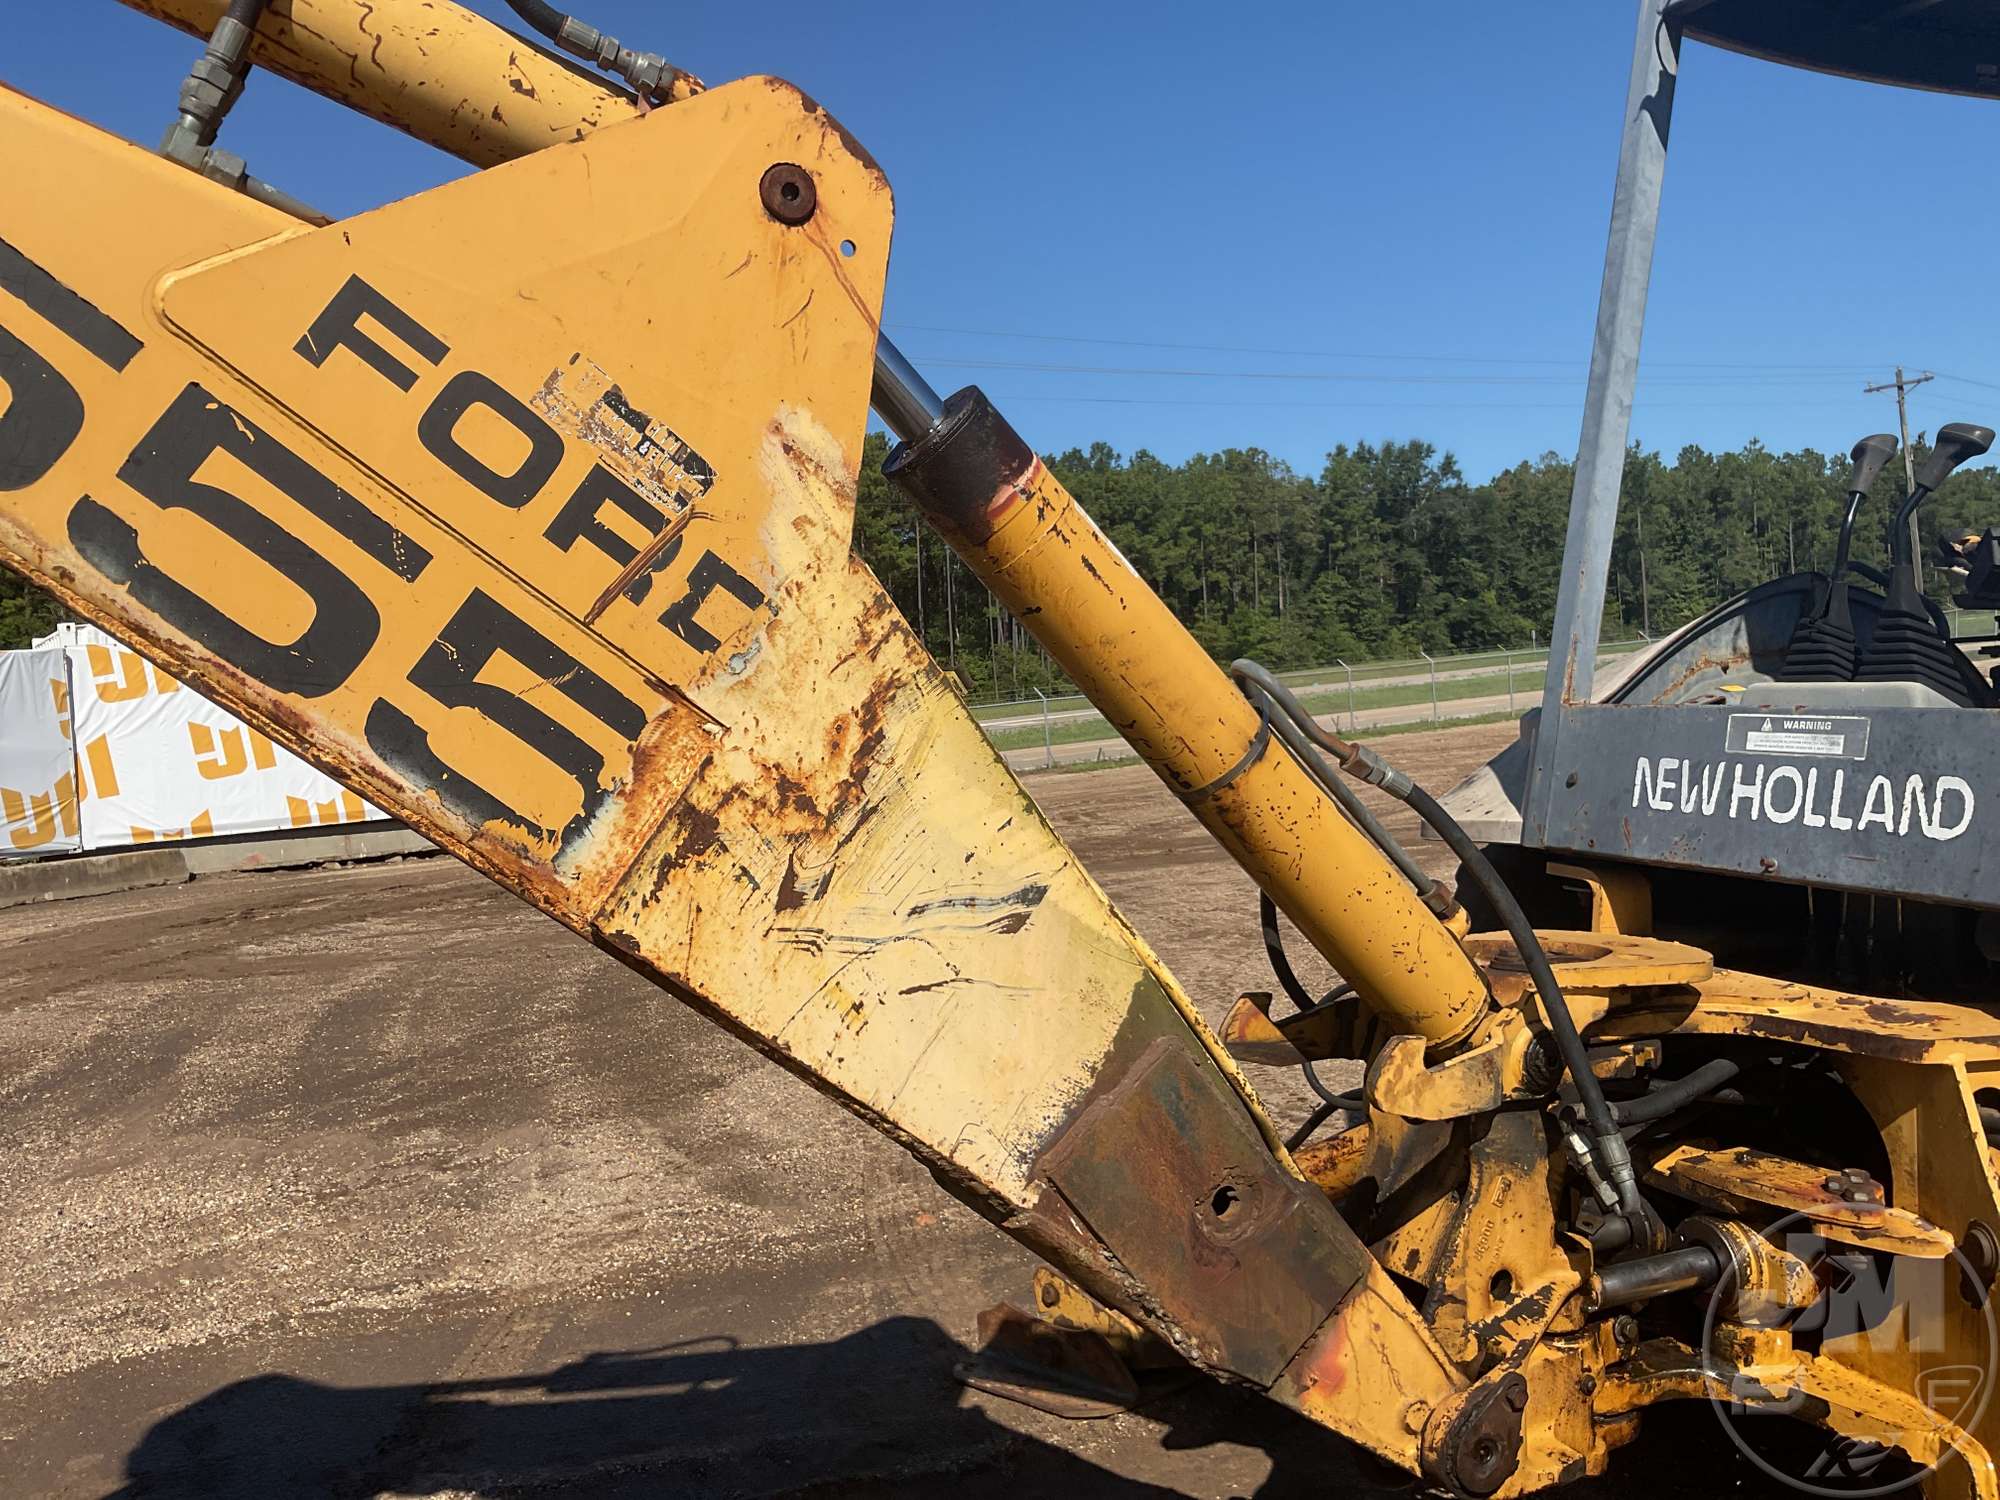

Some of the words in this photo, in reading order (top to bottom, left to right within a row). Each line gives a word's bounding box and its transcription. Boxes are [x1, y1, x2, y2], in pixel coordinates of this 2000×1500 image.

[1783, 720, 1832, 731] WARNING
[1632, 757, 1726, 815] NEW
[1729, 763, 1975, 840] HOLLAND
